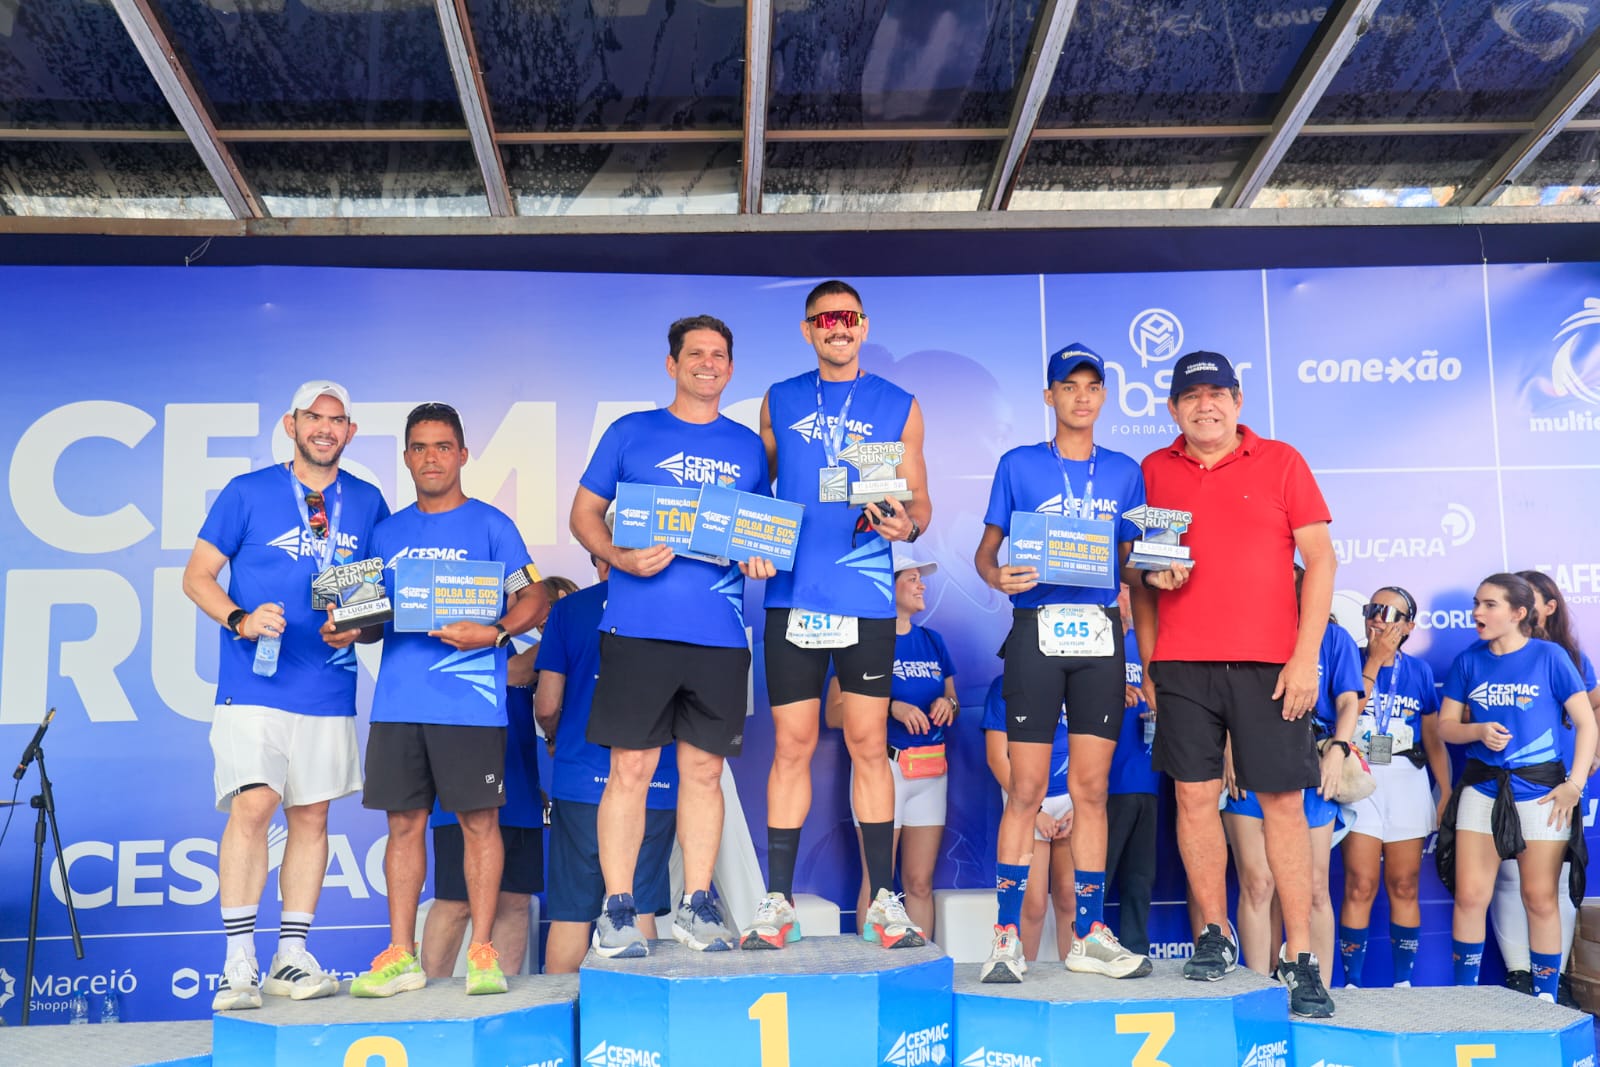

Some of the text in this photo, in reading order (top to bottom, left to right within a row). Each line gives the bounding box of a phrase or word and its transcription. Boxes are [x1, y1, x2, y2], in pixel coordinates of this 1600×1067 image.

[1298, 350, 1462, 384] conexão
[1111, 424, 1183, 435] FORMAT
[860, 444, 904, 454] CESMAC
[684, 455, 741, 478] CESMAC
[860, 454, 883, 463] RUN
[684, 467, 716, 484] RUN
[656, 508, 695, 532] TÊN
[1146, 510, 1191, 522] CESMAC
[1146, 518, 1169, 529] RUN
[763, 523, 776, 535] DE
[301, 530, 359, 549] CMAC
[1049, 540, 1076, 552] BOLSA
[1078, 543, 1089, 553] DE
[408, 547, 469, 560] CESMAC
[1333, 538, 1446, 564] AJUÇARA
[335, 559, 383, 578] CESMAC
[337, 573, 363, 588] RUN
[1535, 564, 1600, 593] AFE
[435, 587, 463, 598] BOLSA
[465, 588, 476, 598] DE
[801, 614, 831, 630] 751
[1412, 610, 1477, 630] CORD
[1053, 621, 1090, 638] 645
[903, 661, 942, 671] CESMAC
[905, 668, 931, 678] RUN
[1125, 671, 1142, 684] UN
[1488, 683, 1540, 697] CESMAC
[1488, 694, 1515, 706] RUN
[50, 835, 426, 909] CESA
[31, 968, 138, 998] Maceió
[29, 999, 82, 1013] Shoppi
[747, 992, 791, 1067] 1
[906, 1022, 949, 1050] CESMAC
[607, 1045, 661, 1067] CESMAC
[906, 1044, 931, 1067] RUN
[1257, 1040, 1288, 1058] CESMAC
